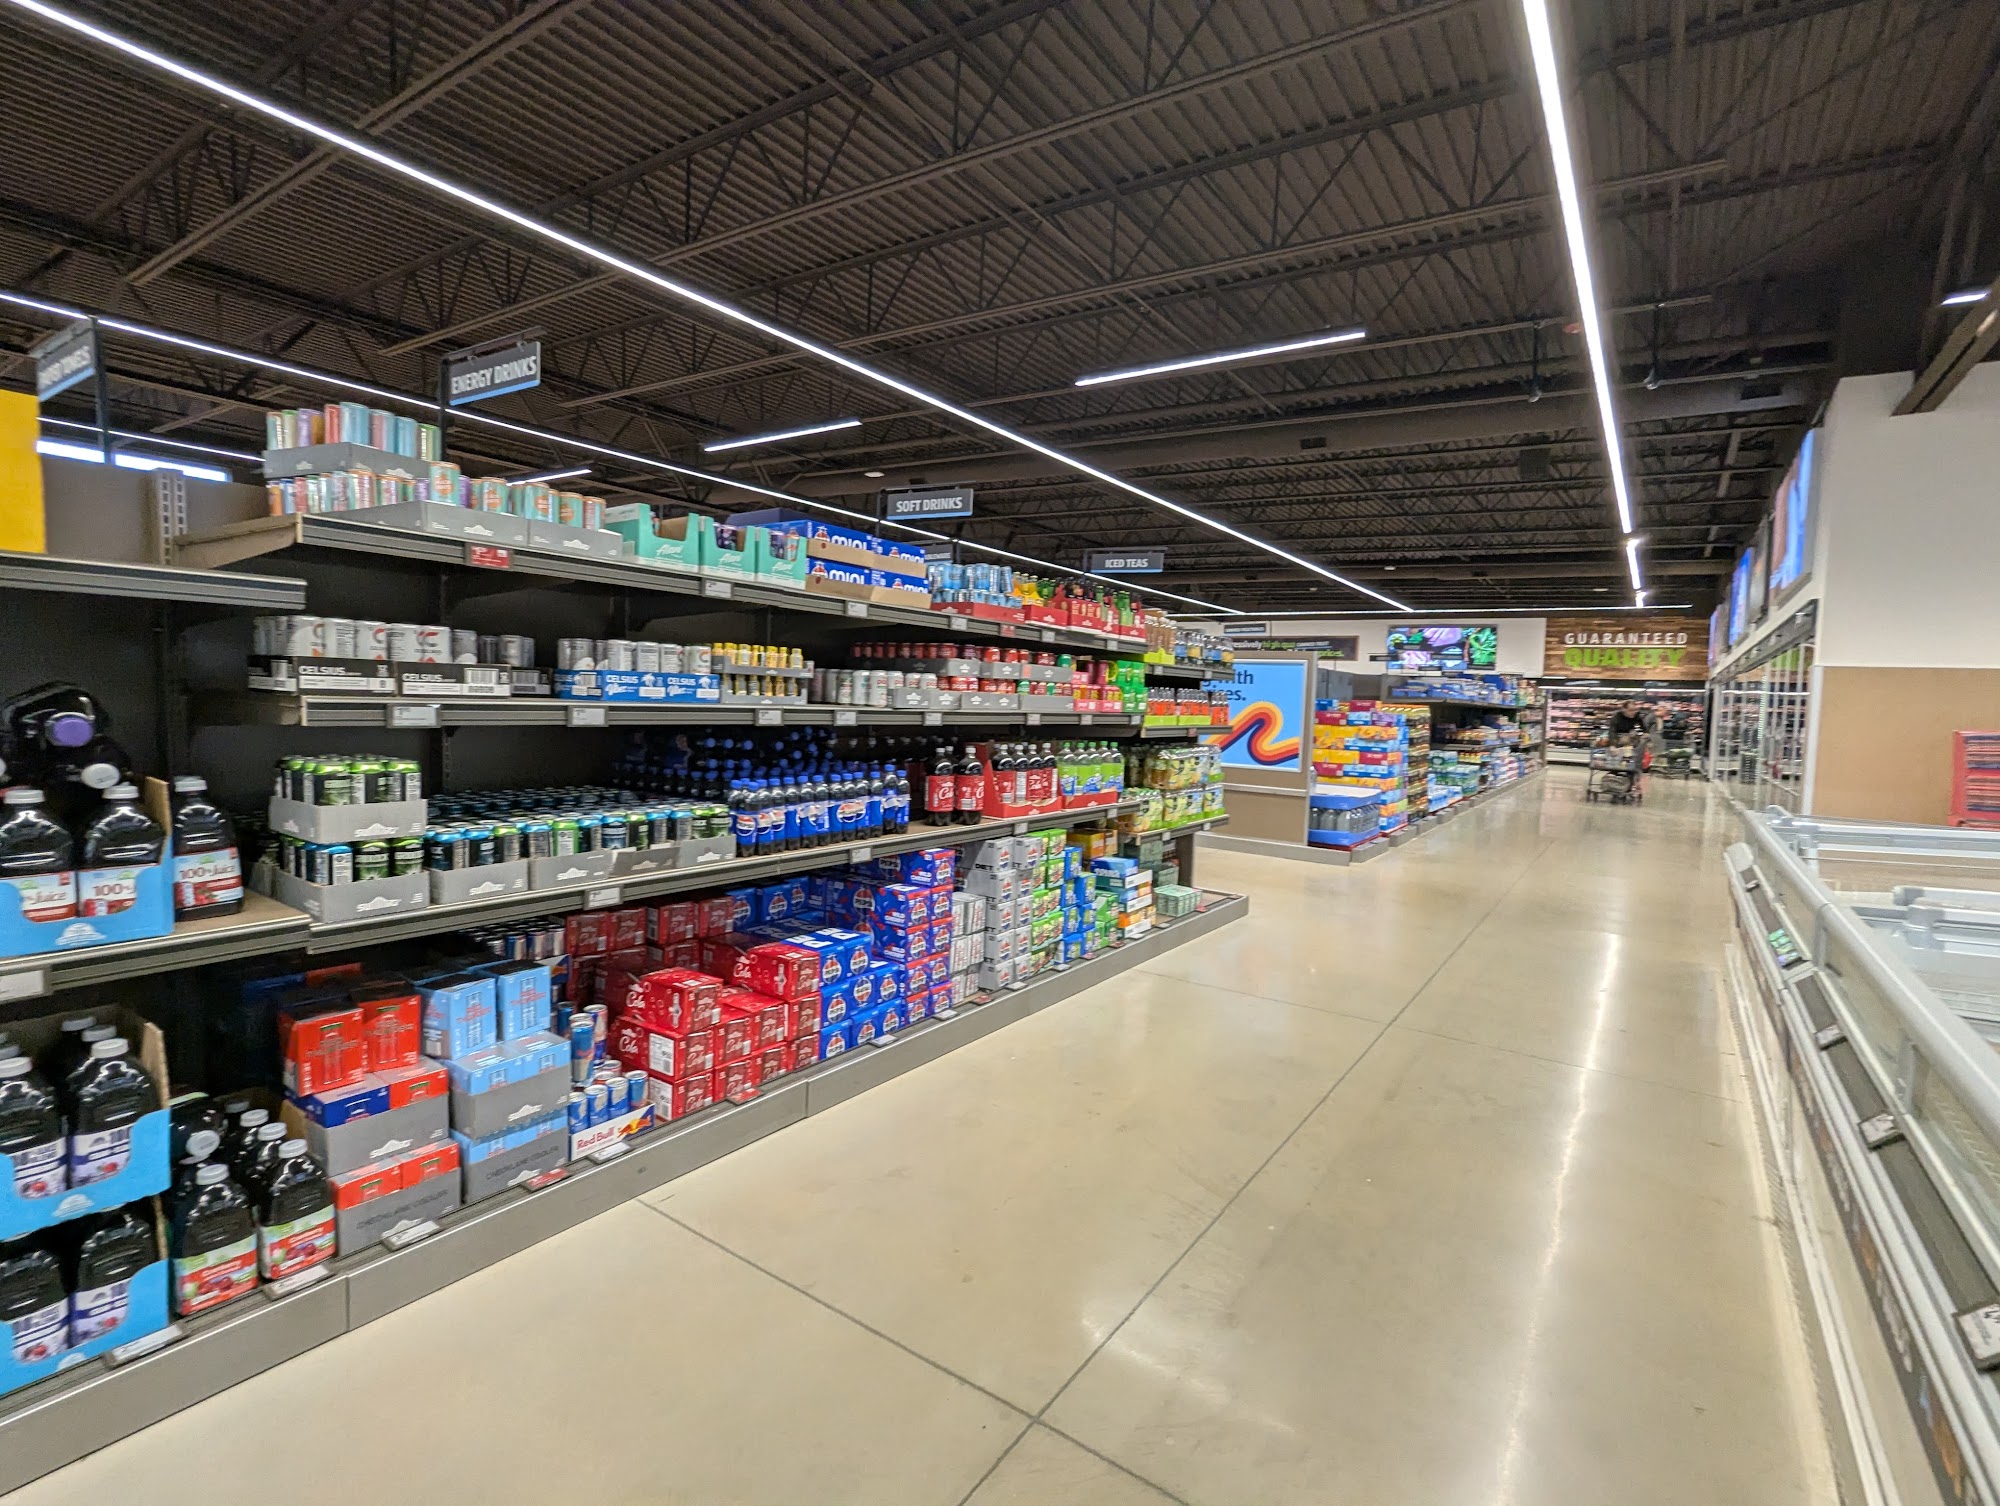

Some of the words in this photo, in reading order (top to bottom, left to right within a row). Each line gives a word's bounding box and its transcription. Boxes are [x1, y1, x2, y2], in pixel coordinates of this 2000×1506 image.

[451, 367, 493, 395] ENERGY
[494, 355, 537, 384] DRINKS
[896, 499, 922, 513] SOFT
[922, 496, 963, 511] DRINKS
[1104, 559, 1125, 568] ICED
[1126, 558, 1149, 568] TEAS
[1564, 632, 1689, 645] GUARANTEED
[1564, 647, 1685, 668] QUALITY
[298, 665, 346, 675] CELSIUS
[402, 673, 443, 682] CELSIUS
[605, 674, 639, 684] CELSIUS
[667, 676, 696, 686] CELSIUS
[577, 1136, 597, 1150] Red
[597, 1127, 615, 1142] Bull
